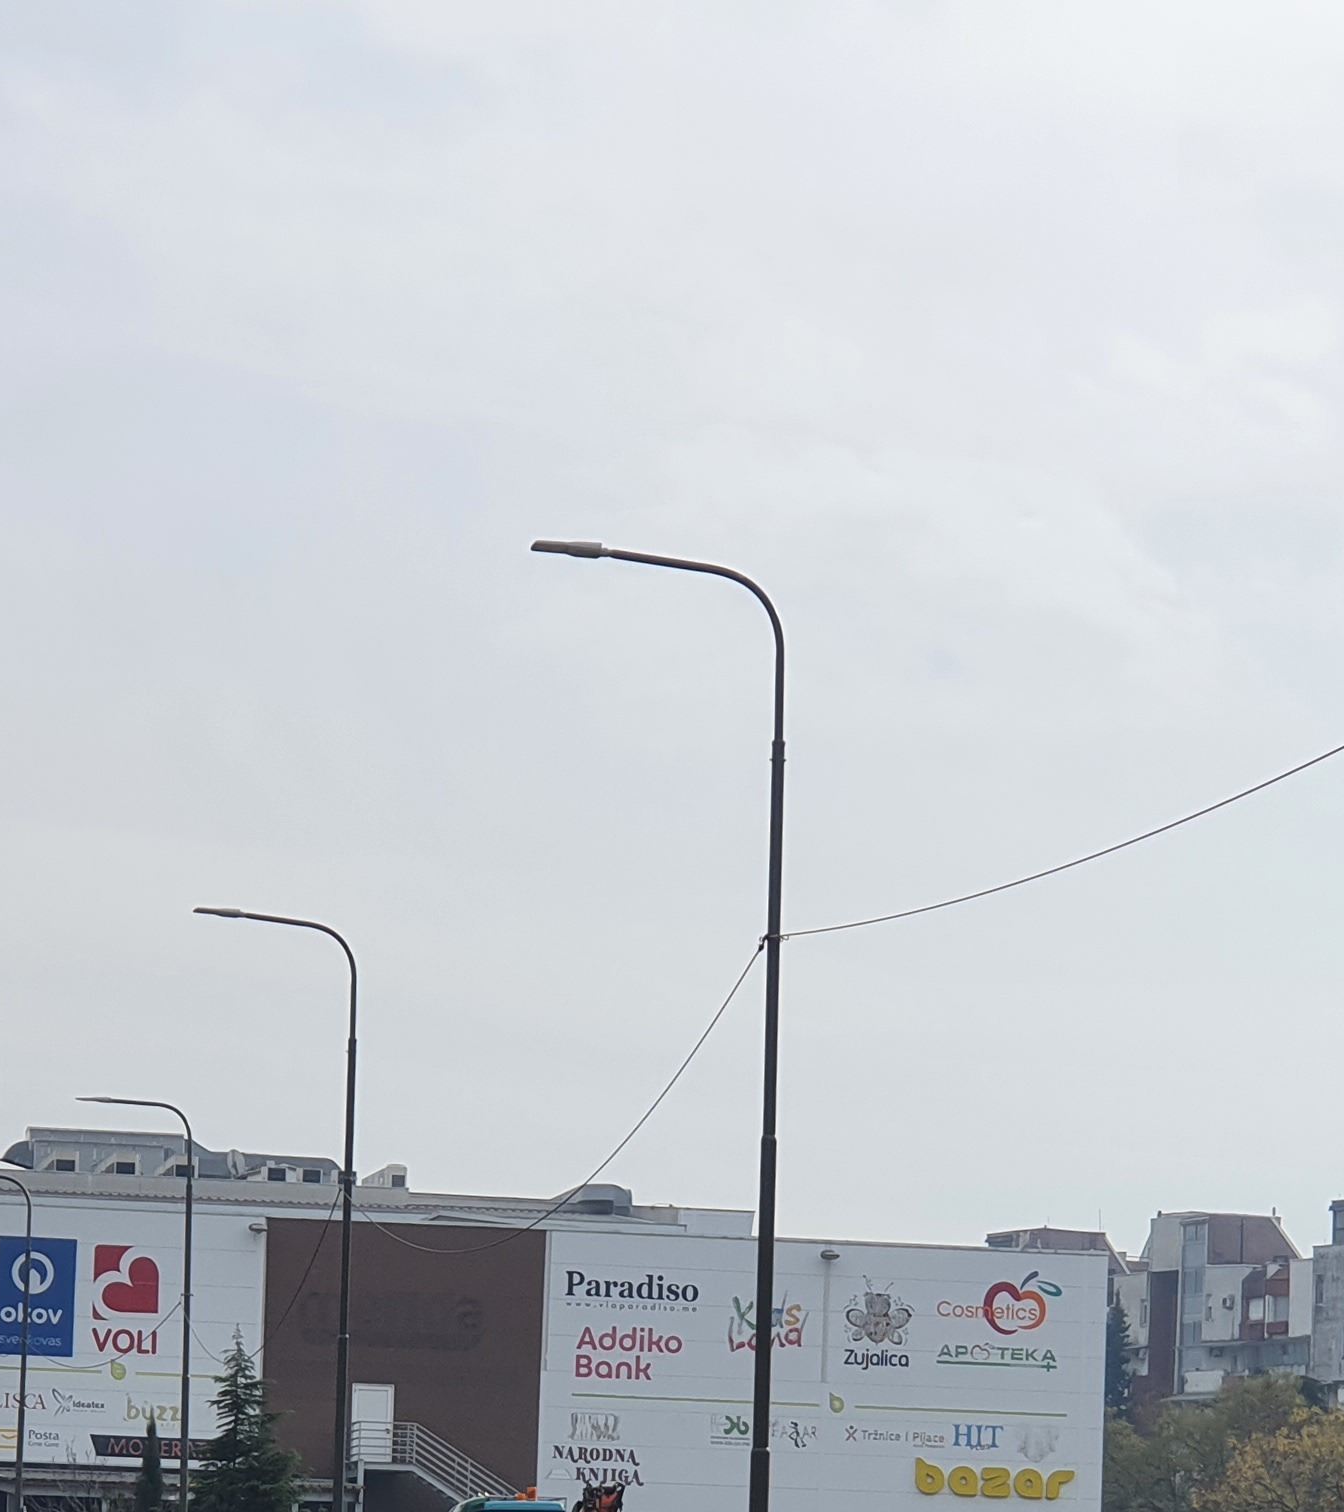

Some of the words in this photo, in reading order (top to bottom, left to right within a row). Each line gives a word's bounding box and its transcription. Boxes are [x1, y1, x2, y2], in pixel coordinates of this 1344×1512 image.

[565, 1270, 699, 1302] Paradiso
[0, 1302, 63, 1325] okov
[732, 1289, 802, 1336] Kds
[936, 1300, 1038, 1321] Cosmetics
[92, 1327, 158, 1355] VOLI
[576, 1325, 683, 1354] Addiko
[575, 1354, 652, 1381] Bank
[843, 1348, 909, 1370] Zujalica
[953, 1424, 1004, 1448] HIT
[552, 1445, 640, 1466] NARODNA
[575, 1466, 645, 1486] KNJIGA
[915, 1457, 1075, 1500] bazar
